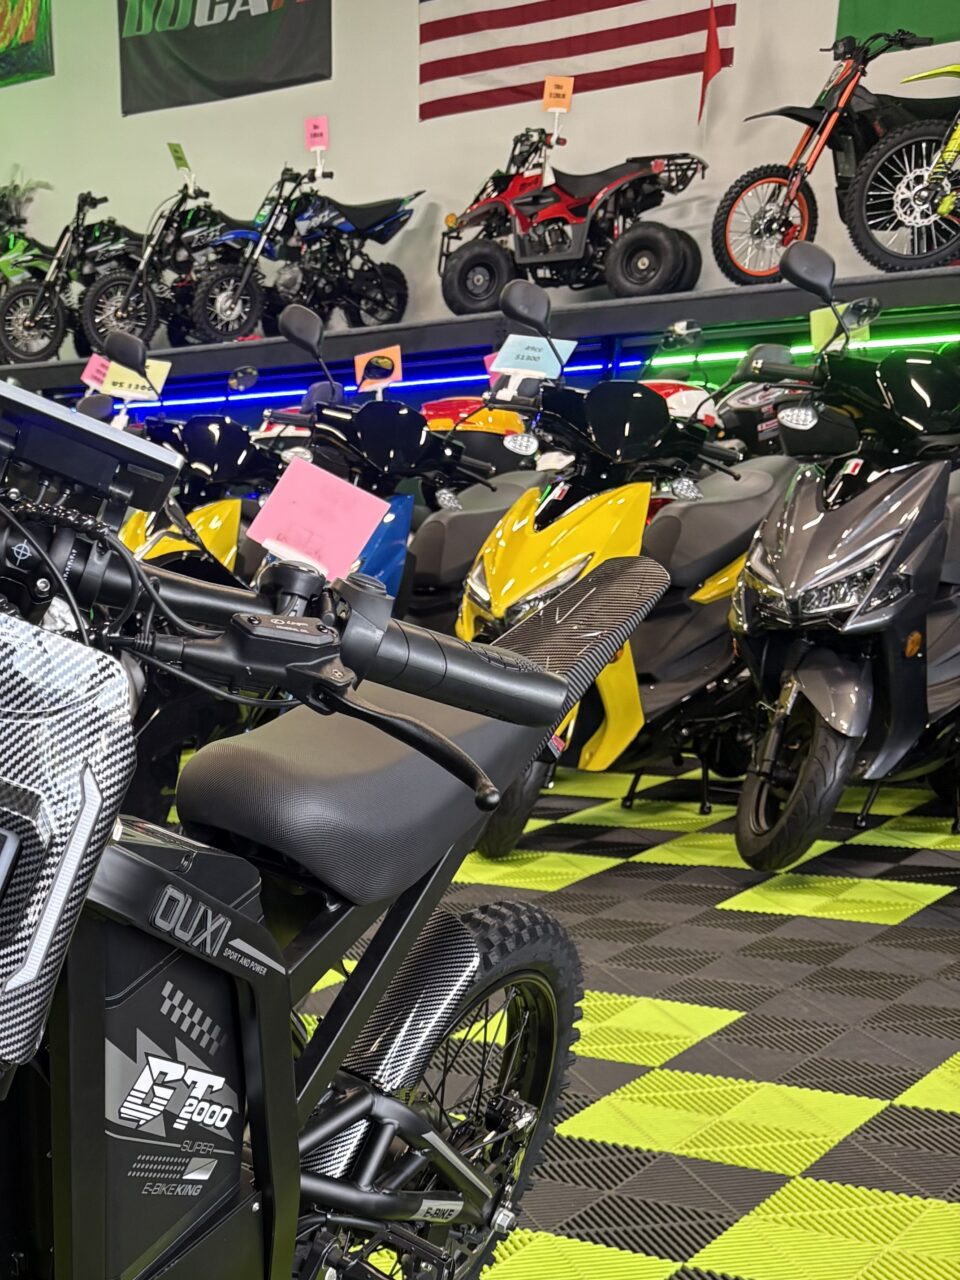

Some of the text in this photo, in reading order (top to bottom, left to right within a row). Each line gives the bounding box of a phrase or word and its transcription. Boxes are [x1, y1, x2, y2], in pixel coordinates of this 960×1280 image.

[223, 947, 268, 976] SPORT AND POWER
[119, 1053, 233, 1131] GT 2000
[181, 1139, 215, 1155] SUPER
